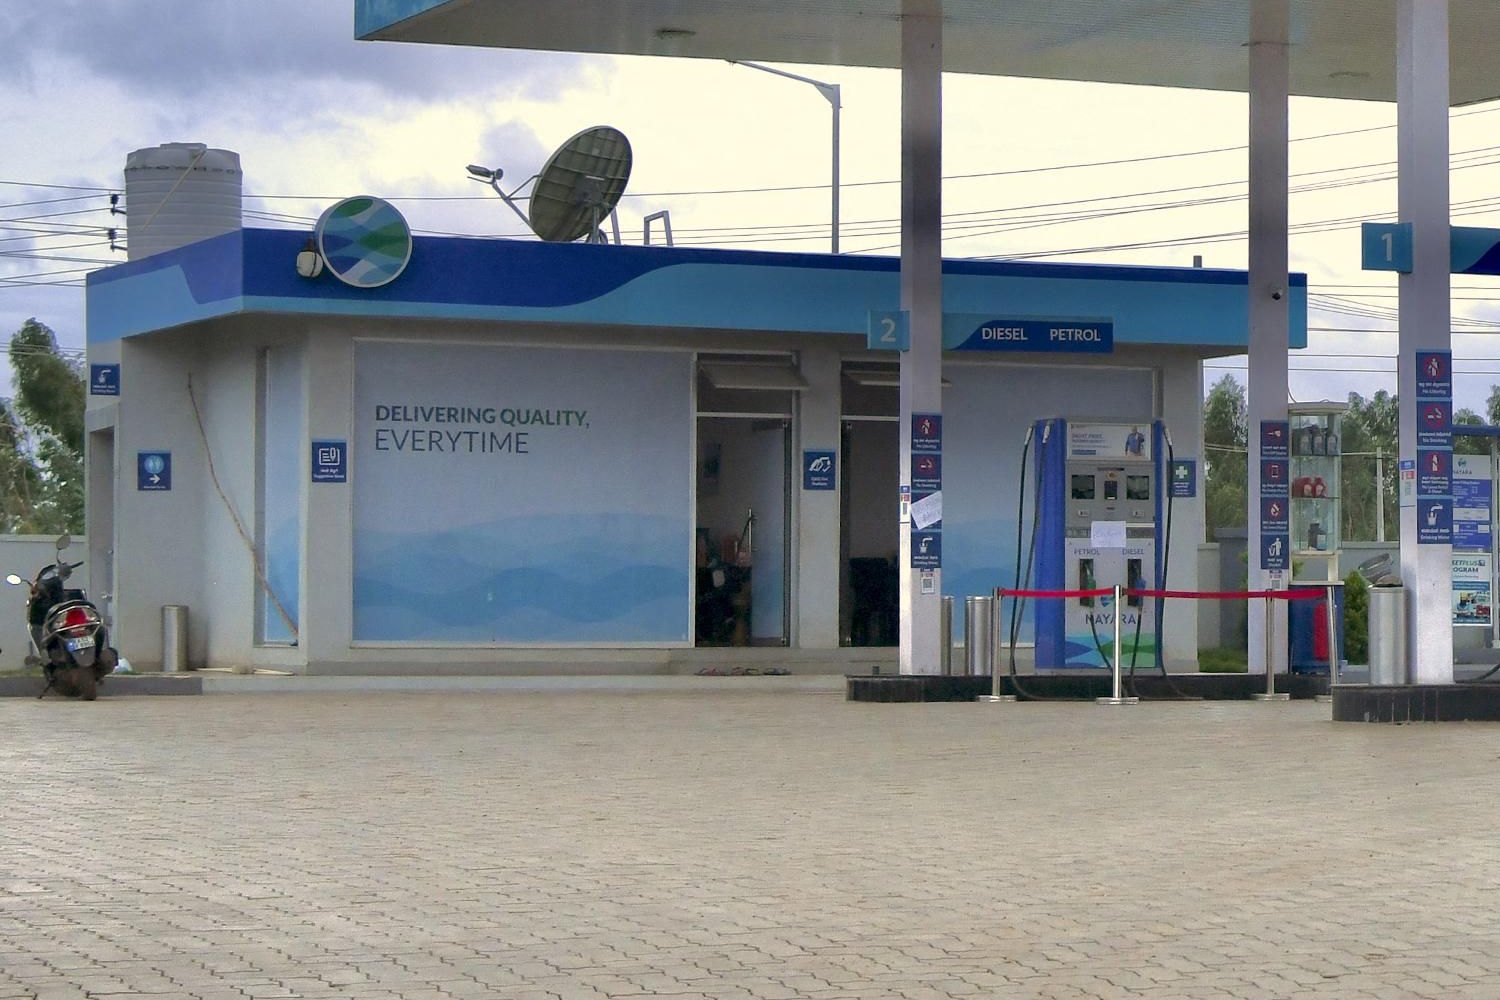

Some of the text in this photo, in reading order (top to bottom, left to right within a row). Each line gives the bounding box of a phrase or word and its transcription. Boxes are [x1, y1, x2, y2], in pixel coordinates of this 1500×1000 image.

[1381, 232, 1393, 262] 1
[880, 318, 897, 342] 2
[981, 327, 1101, 342] DIESEL PETROL
[375, 405, 590, 429] DELIVERING QUALITY,
[375, 429, 529, 454] EVERYTIME
